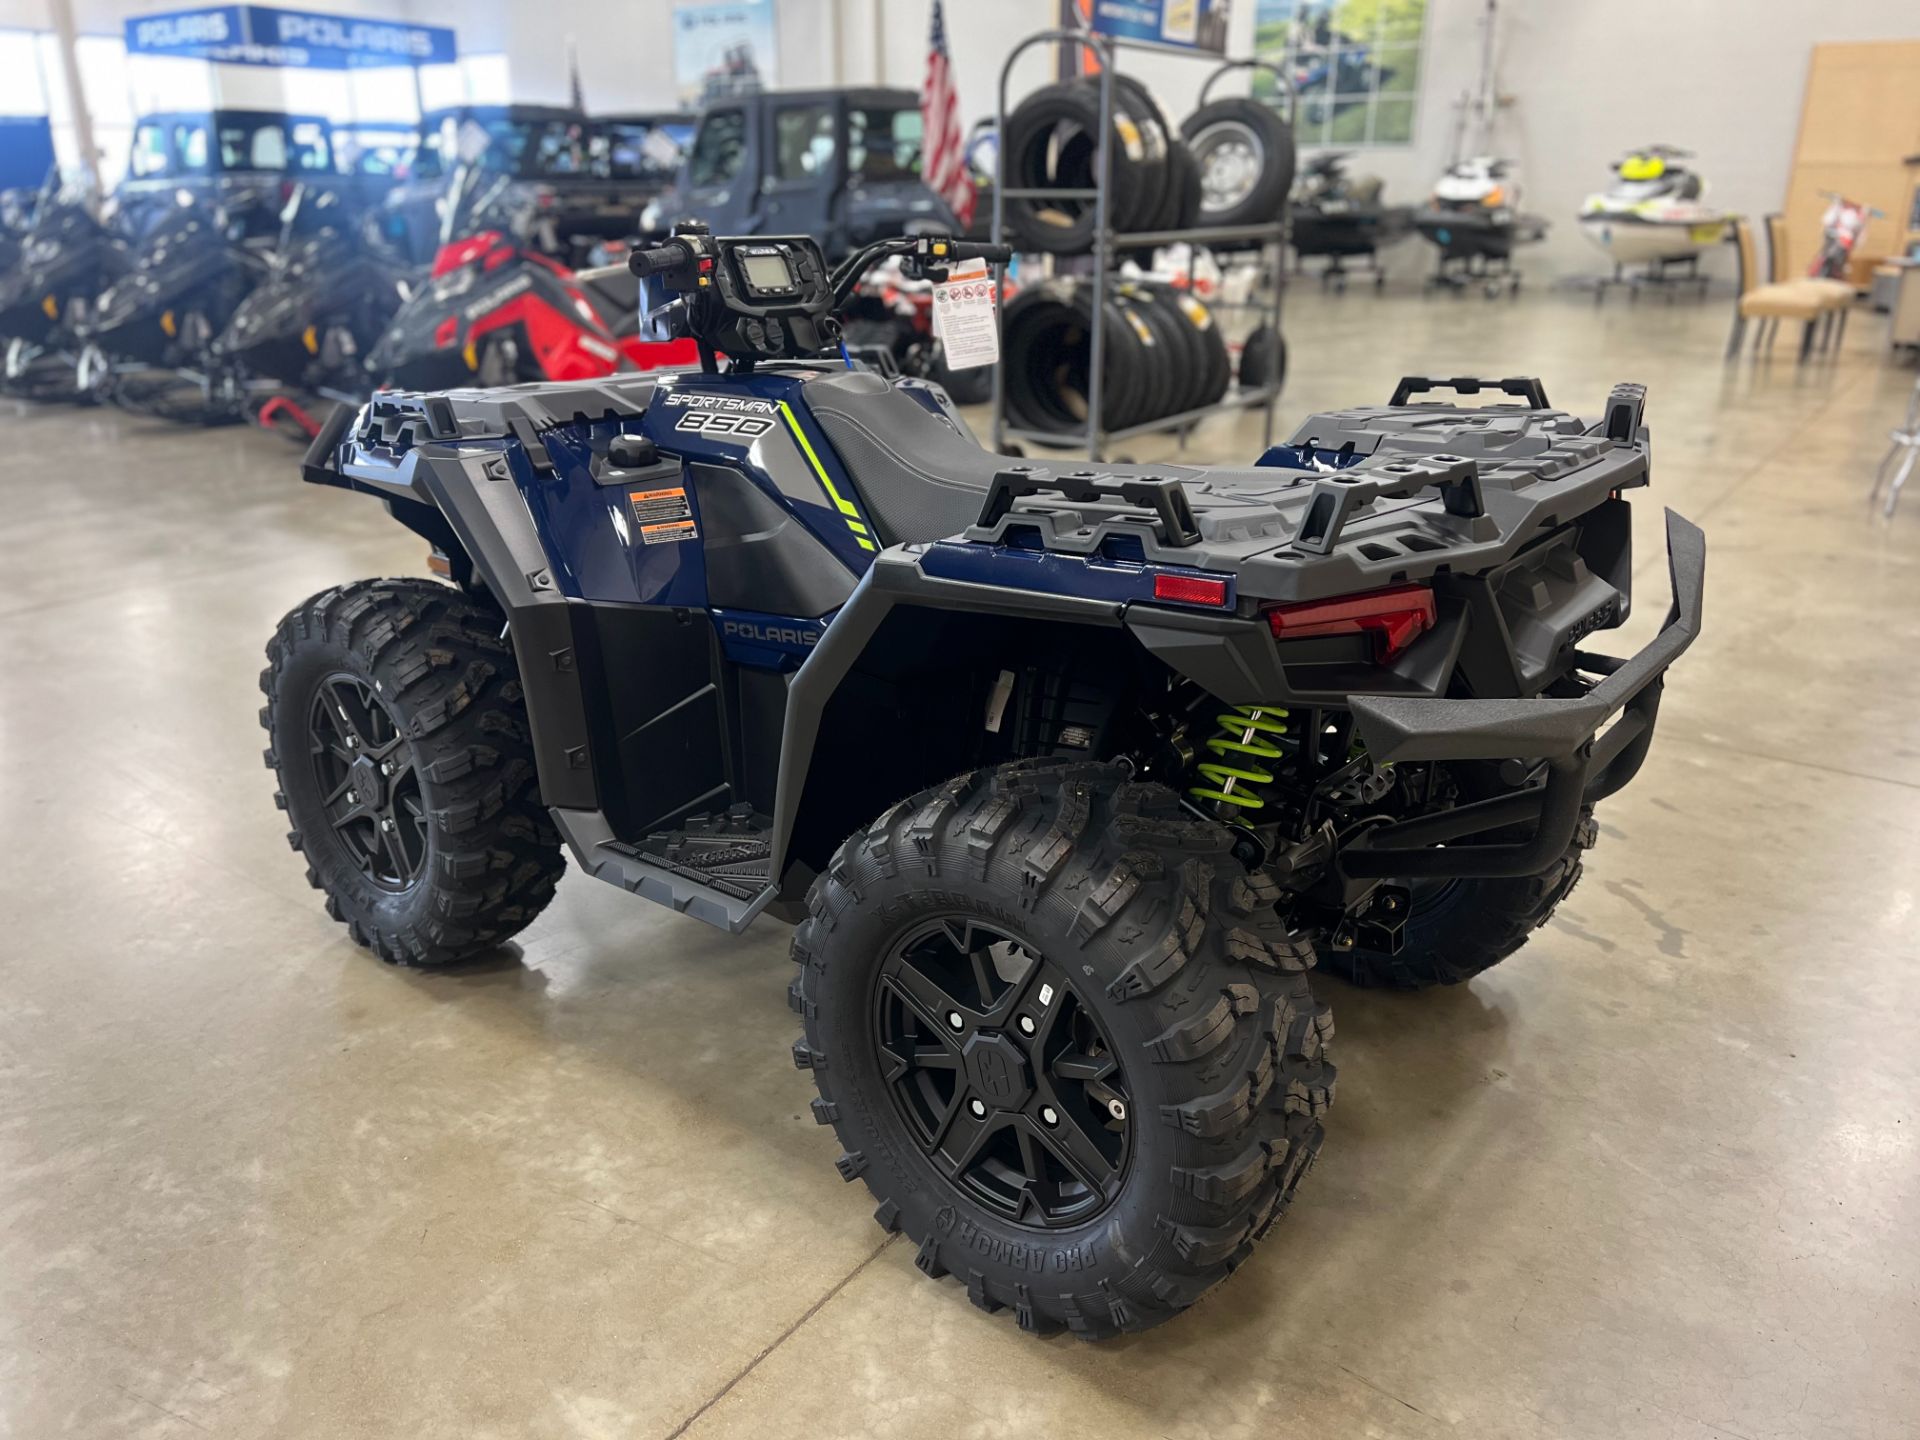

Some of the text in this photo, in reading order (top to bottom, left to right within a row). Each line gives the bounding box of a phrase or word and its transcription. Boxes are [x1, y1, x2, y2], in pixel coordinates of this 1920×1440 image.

[664, 393, 781, 415] SPORTSMAN
[675, 410, 776, 438] 850
[724, 621, 819, 646] POLARIS
[959, 1219, 1098, 1274] PRO ARMOR
